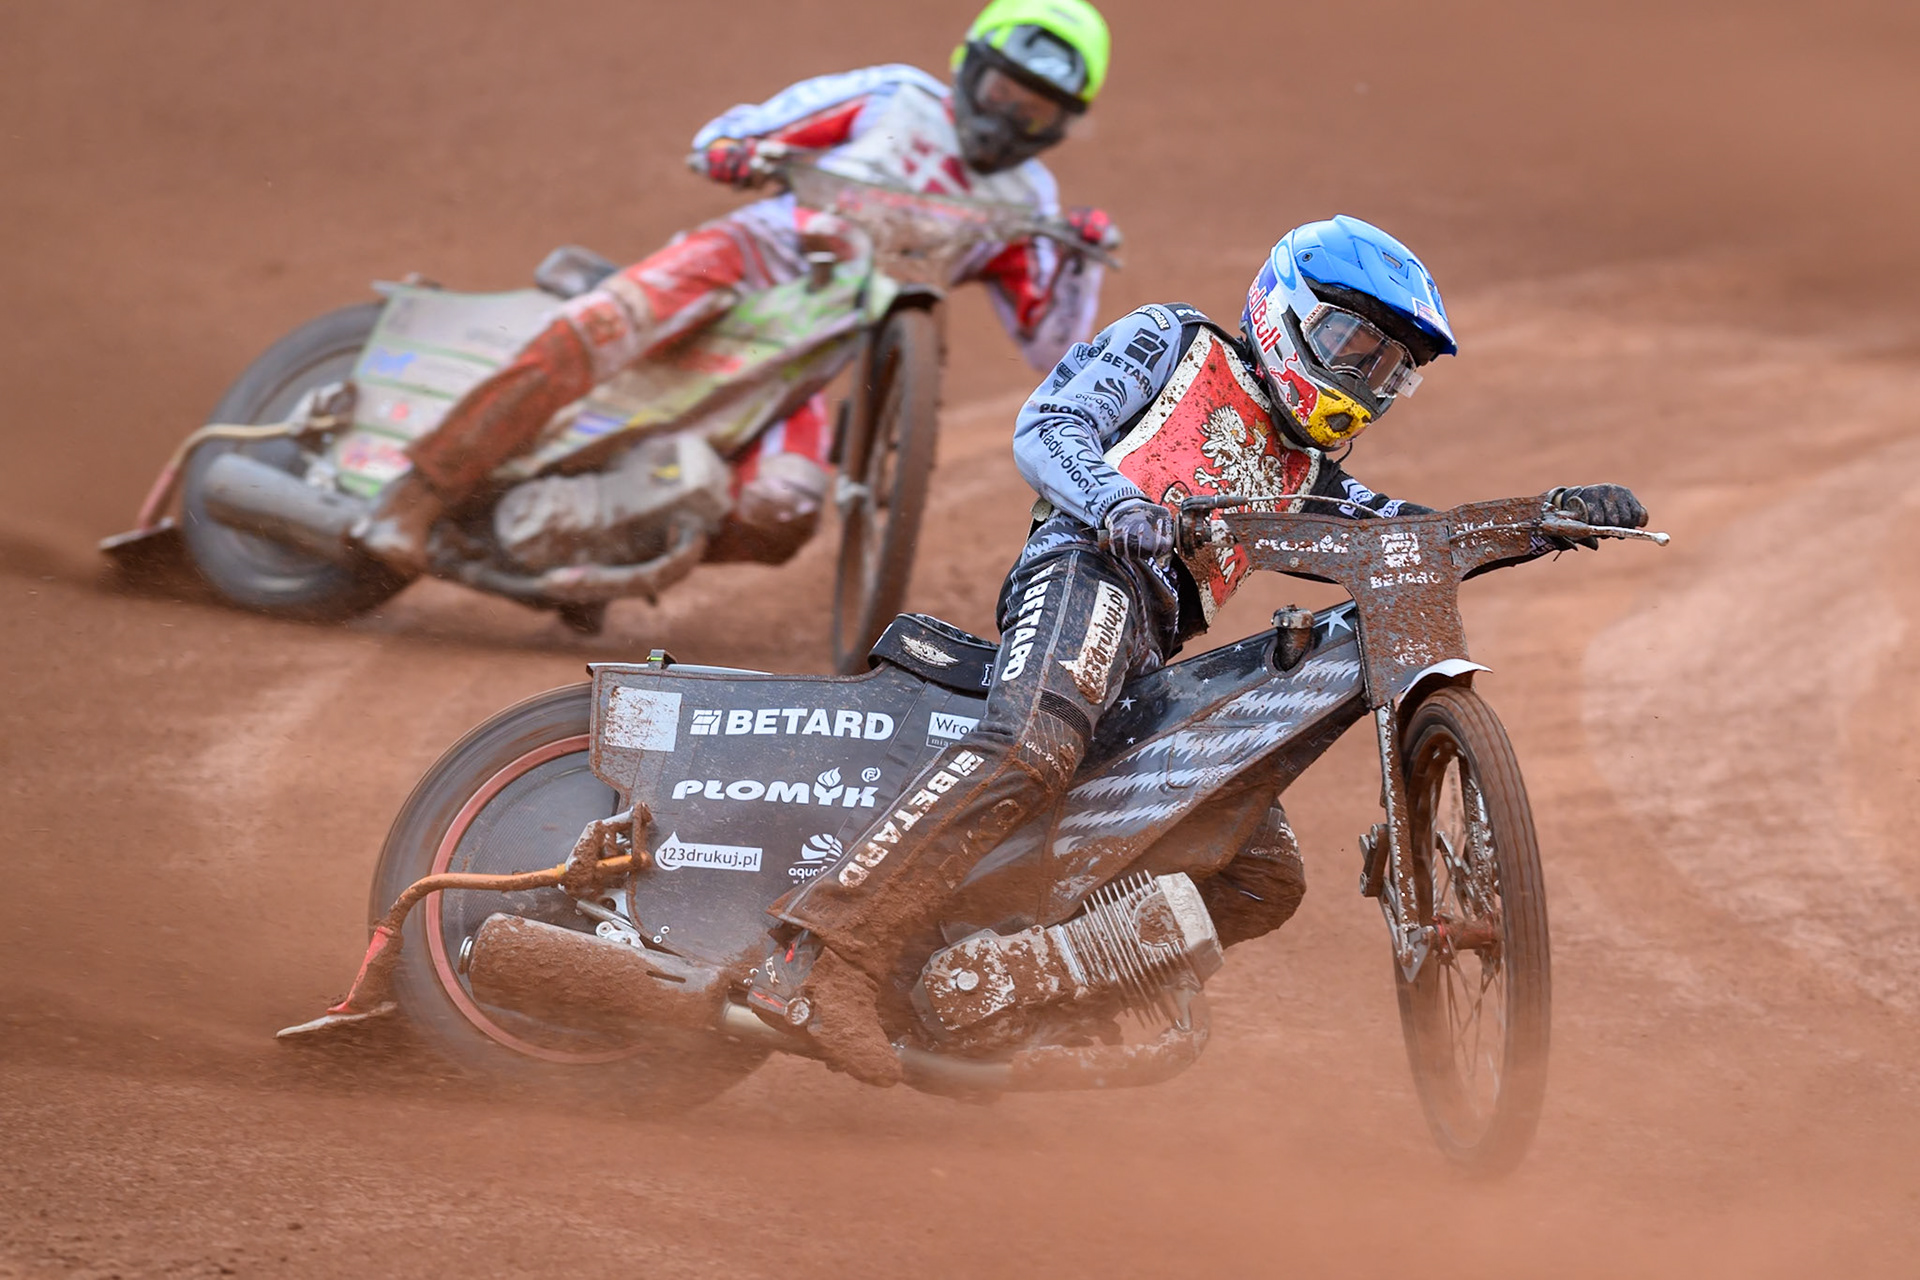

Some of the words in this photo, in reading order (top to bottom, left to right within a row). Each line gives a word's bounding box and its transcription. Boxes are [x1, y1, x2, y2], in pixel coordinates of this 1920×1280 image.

[1251, 298, 1282, 354] Bull
[1100, 352, 1153, 399] BETARD
[1075, 393, 1119, 427] aquapark
[1001, 580, 1051, 682] BETARD
[725, 708, 894, 741] BETARD
[936, 717, 973, 735] Wro
[838, 771, 959, 888] BETARD
[661, 847, 758, 867] 123drukuj.pl
